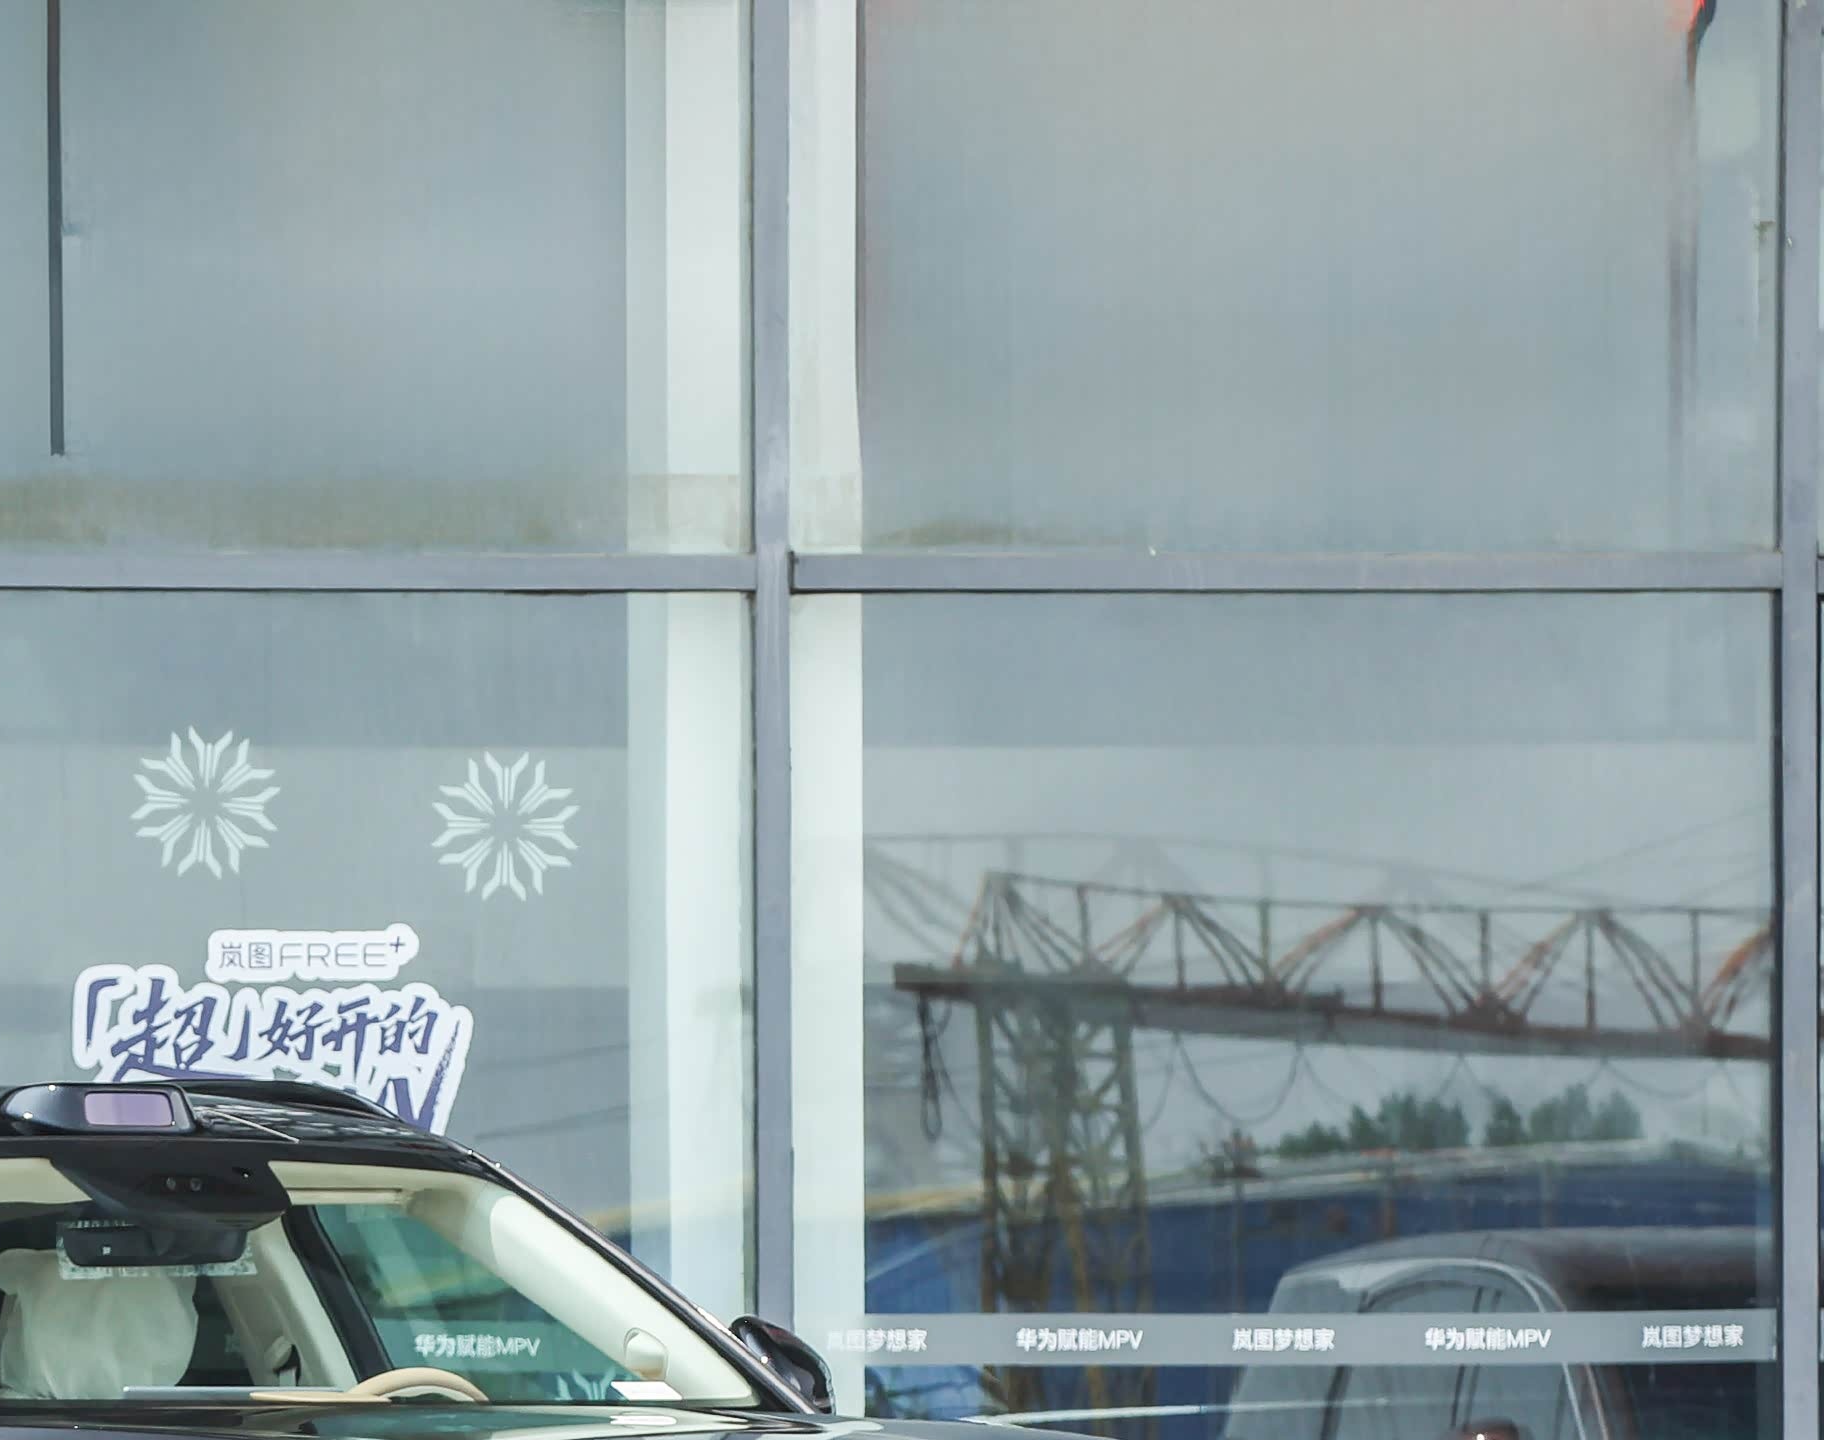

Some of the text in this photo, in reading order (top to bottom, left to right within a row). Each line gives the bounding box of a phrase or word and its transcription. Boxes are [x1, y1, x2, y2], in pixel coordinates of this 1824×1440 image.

[414, 1333, 541, 1358] 华为赋能MPV
[1016, 1327, 1143, 1352] 华为赋能MPV
[1232, 1328, 1335, 1351] 岚图梦想家
[1425, 1326, 1551, 1351] 华为赋能MPV
[1642, 1325, 1744, 1349] 岚图梦想家
